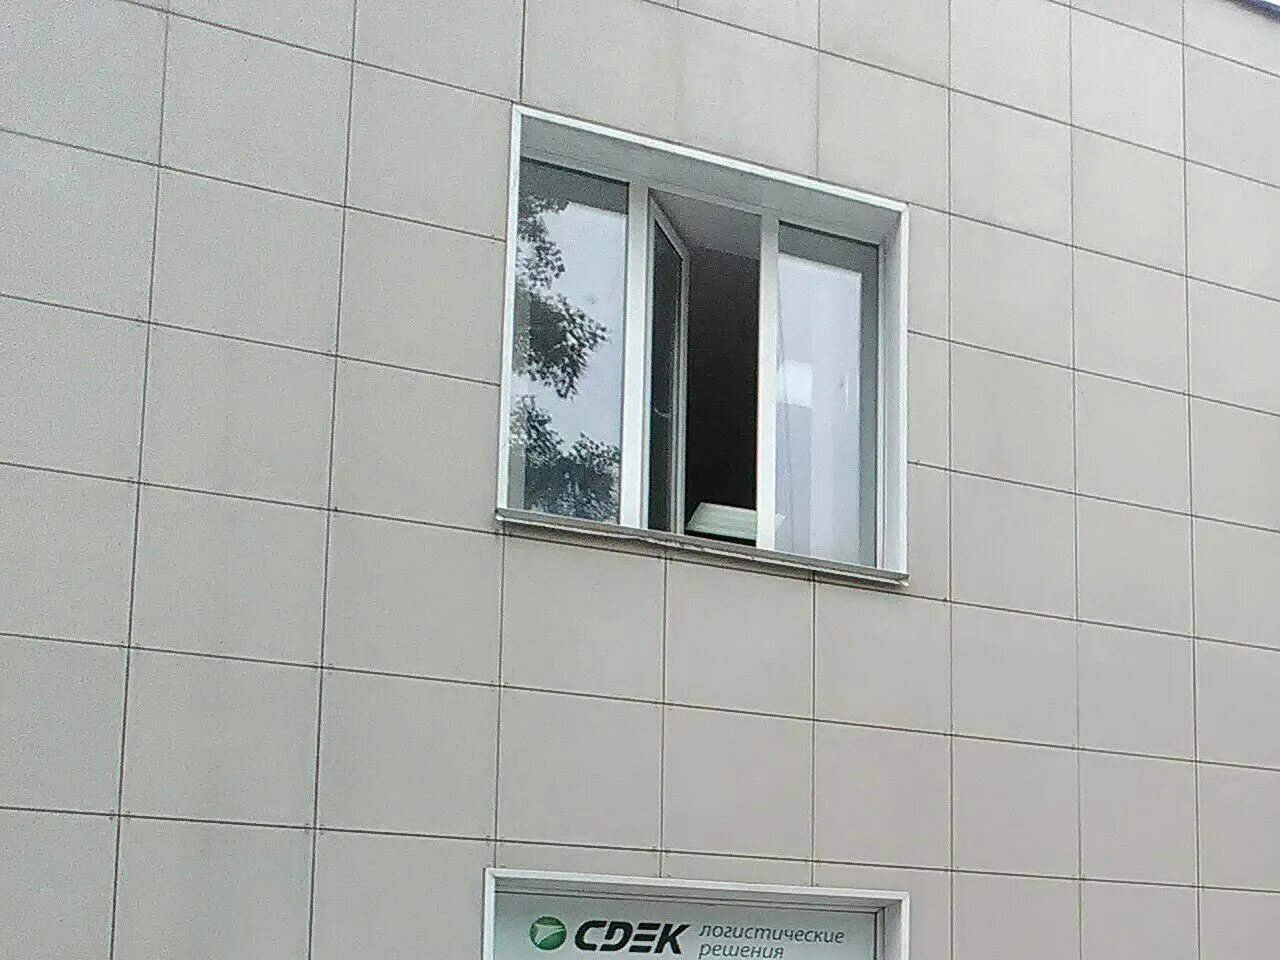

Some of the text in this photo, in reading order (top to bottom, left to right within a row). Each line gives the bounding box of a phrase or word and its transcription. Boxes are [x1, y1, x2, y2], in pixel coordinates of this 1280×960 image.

[574, 919, 691, 955] CDEK
[698, 922, 845, 944] логистические
[697, 941, 785, 960] решения
